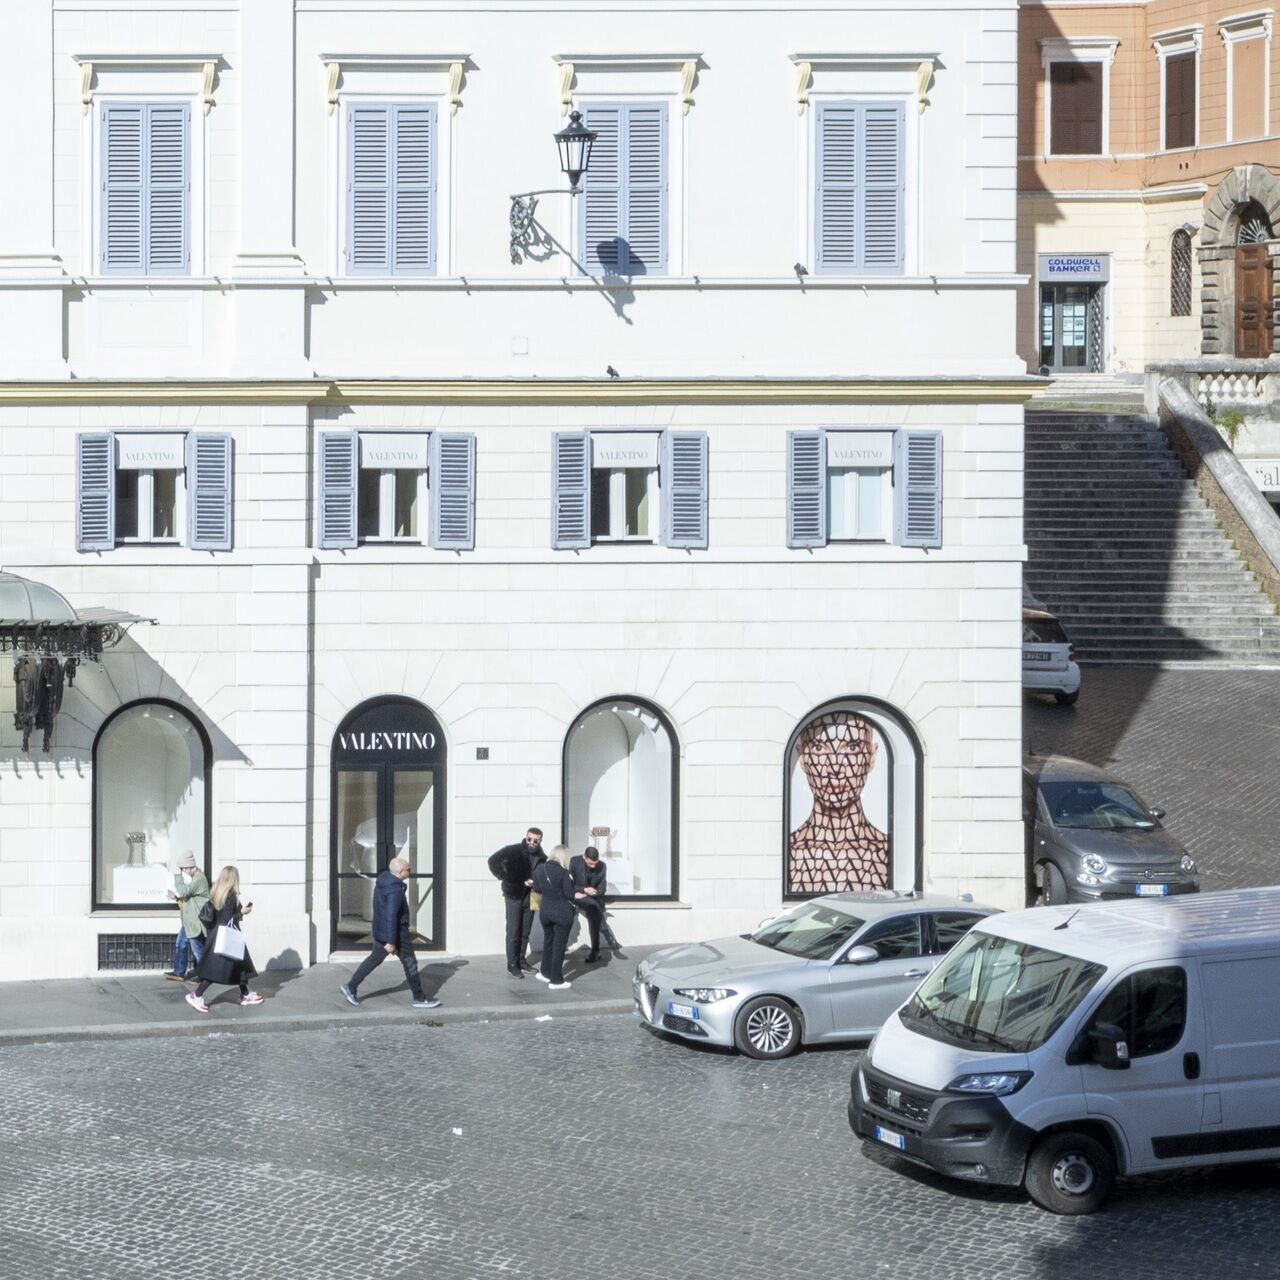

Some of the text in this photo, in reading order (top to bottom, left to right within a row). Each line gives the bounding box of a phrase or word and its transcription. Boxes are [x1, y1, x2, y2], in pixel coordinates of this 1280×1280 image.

[125, 452, 175, 461] VALENTINO
[369, 451, 418, 461] VALENTINO
[599, 451, 649, 460] VALENTINO
[834, 450, 883, 459] VALENTINO
[340, 732, 436, 750] VALENTINO
